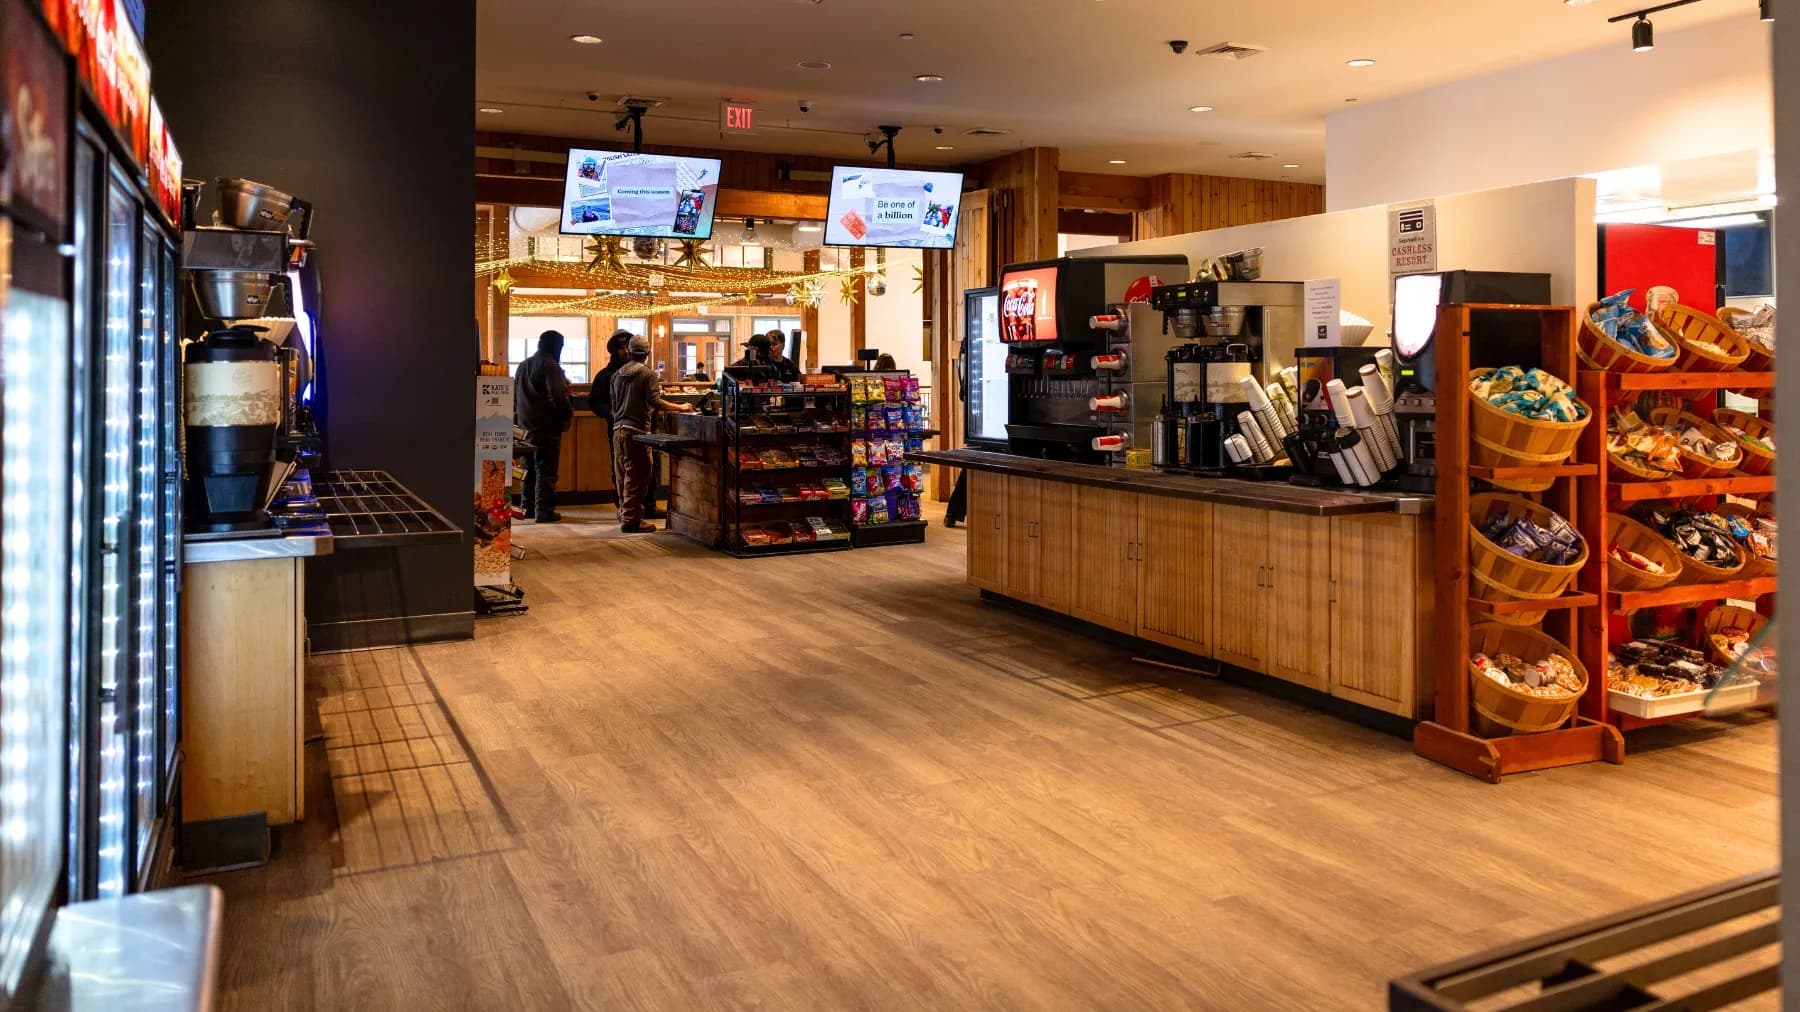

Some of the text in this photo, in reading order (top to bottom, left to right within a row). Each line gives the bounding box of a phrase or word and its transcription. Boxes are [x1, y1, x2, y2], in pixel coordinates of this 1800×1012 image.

[727, 106, 752, 128] EXIT
[885, 211, 912, 219] billion
[1391, 244, 1432, 256] CASHLESS
